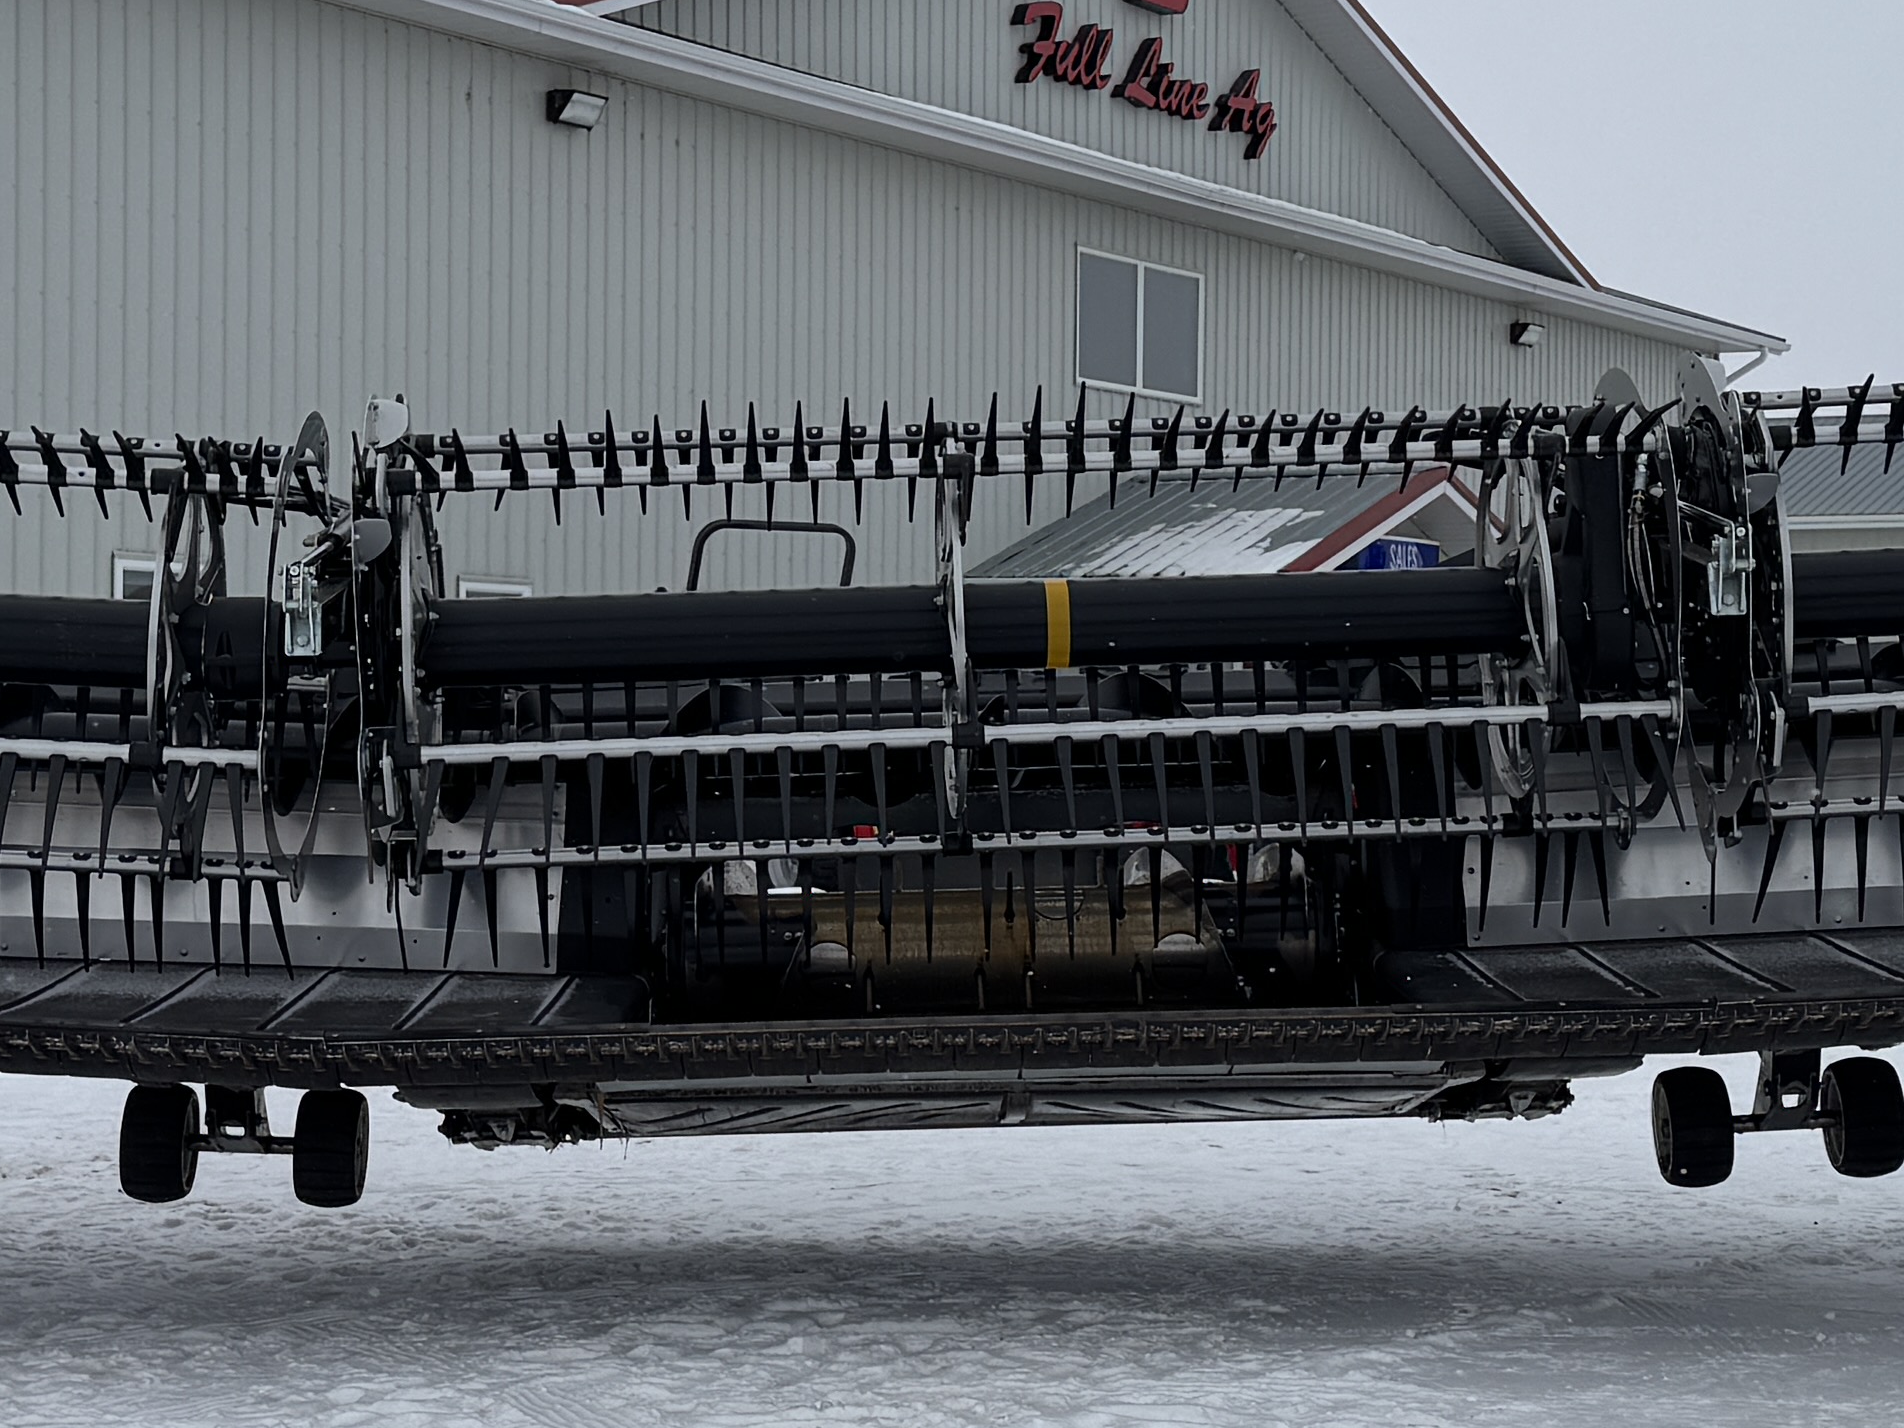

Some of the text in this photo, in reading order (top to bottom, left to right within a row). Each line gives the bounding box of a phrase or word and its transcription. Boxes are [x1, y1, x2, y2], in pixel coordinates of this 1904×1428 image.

[1010, 1, 1277, 160] Full Line Ag
[1389, 544, 1418, 570] SALES
